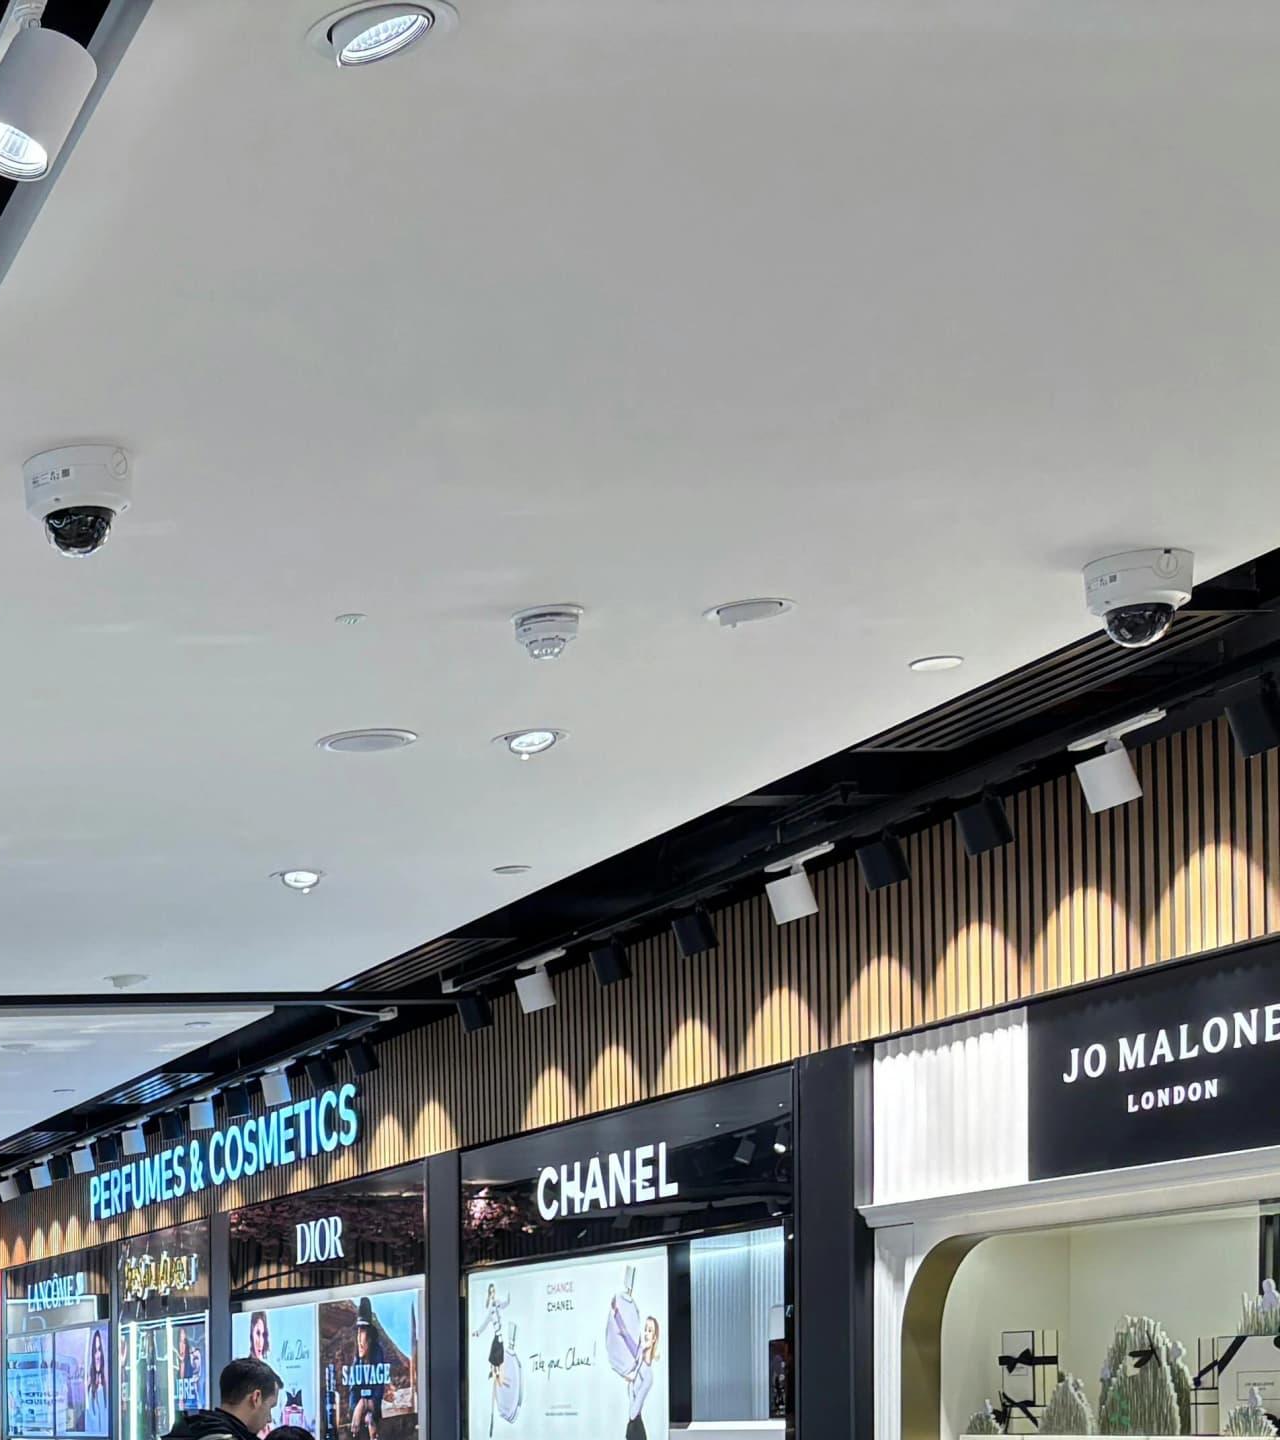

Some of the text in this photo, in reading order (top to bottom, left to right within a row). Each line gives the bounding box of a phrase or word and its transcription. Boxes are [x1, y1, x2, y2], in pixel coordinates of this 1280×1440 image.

[1062, 1003, 1280, 1084] JO MALONE
[1127, 1079, 1218, 1113] LONDON
[90, 1083, 358, 1222] PERFUMES & COSMETICS
[537, 1142, 679, 1221] CHANEL
[296, 1216, 344, 1265] DIOR
[546, 1300, 575, 1312] CHANEL
[342, 1363, 391, 1386] SAUVAGE
